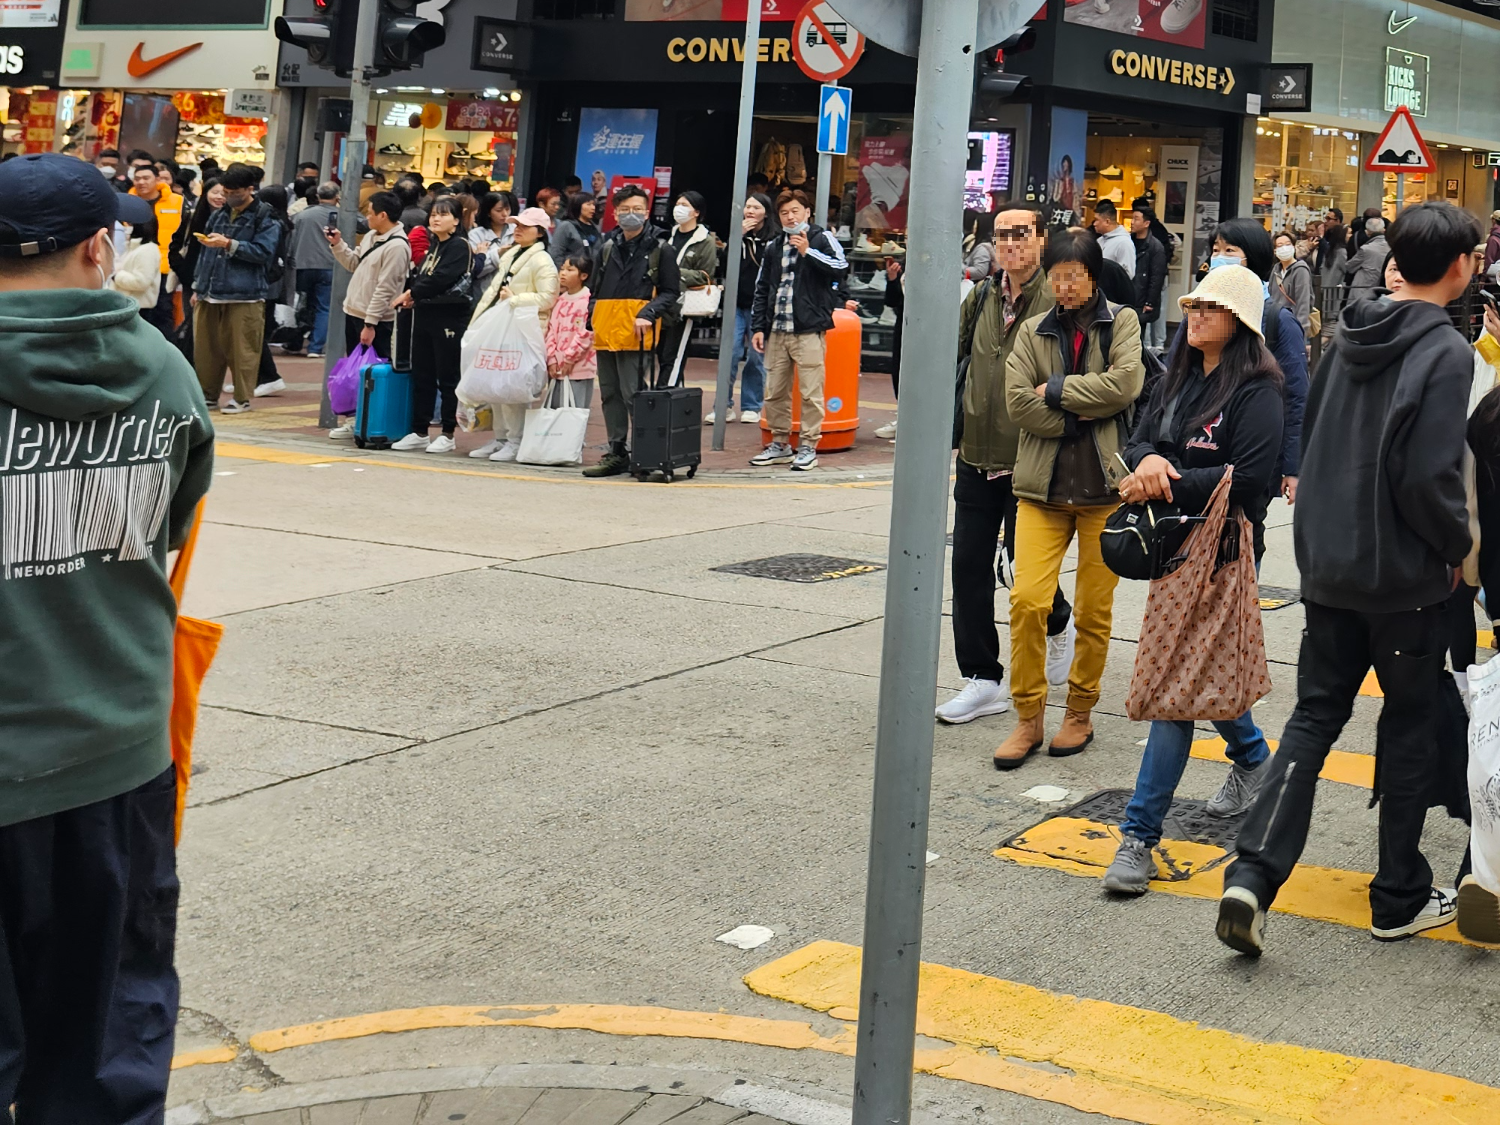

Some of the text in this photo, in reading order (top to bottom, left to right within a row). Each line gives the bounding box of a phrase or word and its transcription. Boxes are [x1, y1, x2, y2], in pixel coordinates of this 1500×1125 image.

[481, 51, 514, 60] CONVERSE
[1111, 48, 1218, 90] CONVERSE
[1387, 65, 1415, 90] KICKS
[1387, 85, 1422, 111] LOUNGE
[14, 557, 86, 579] NEWORDER
